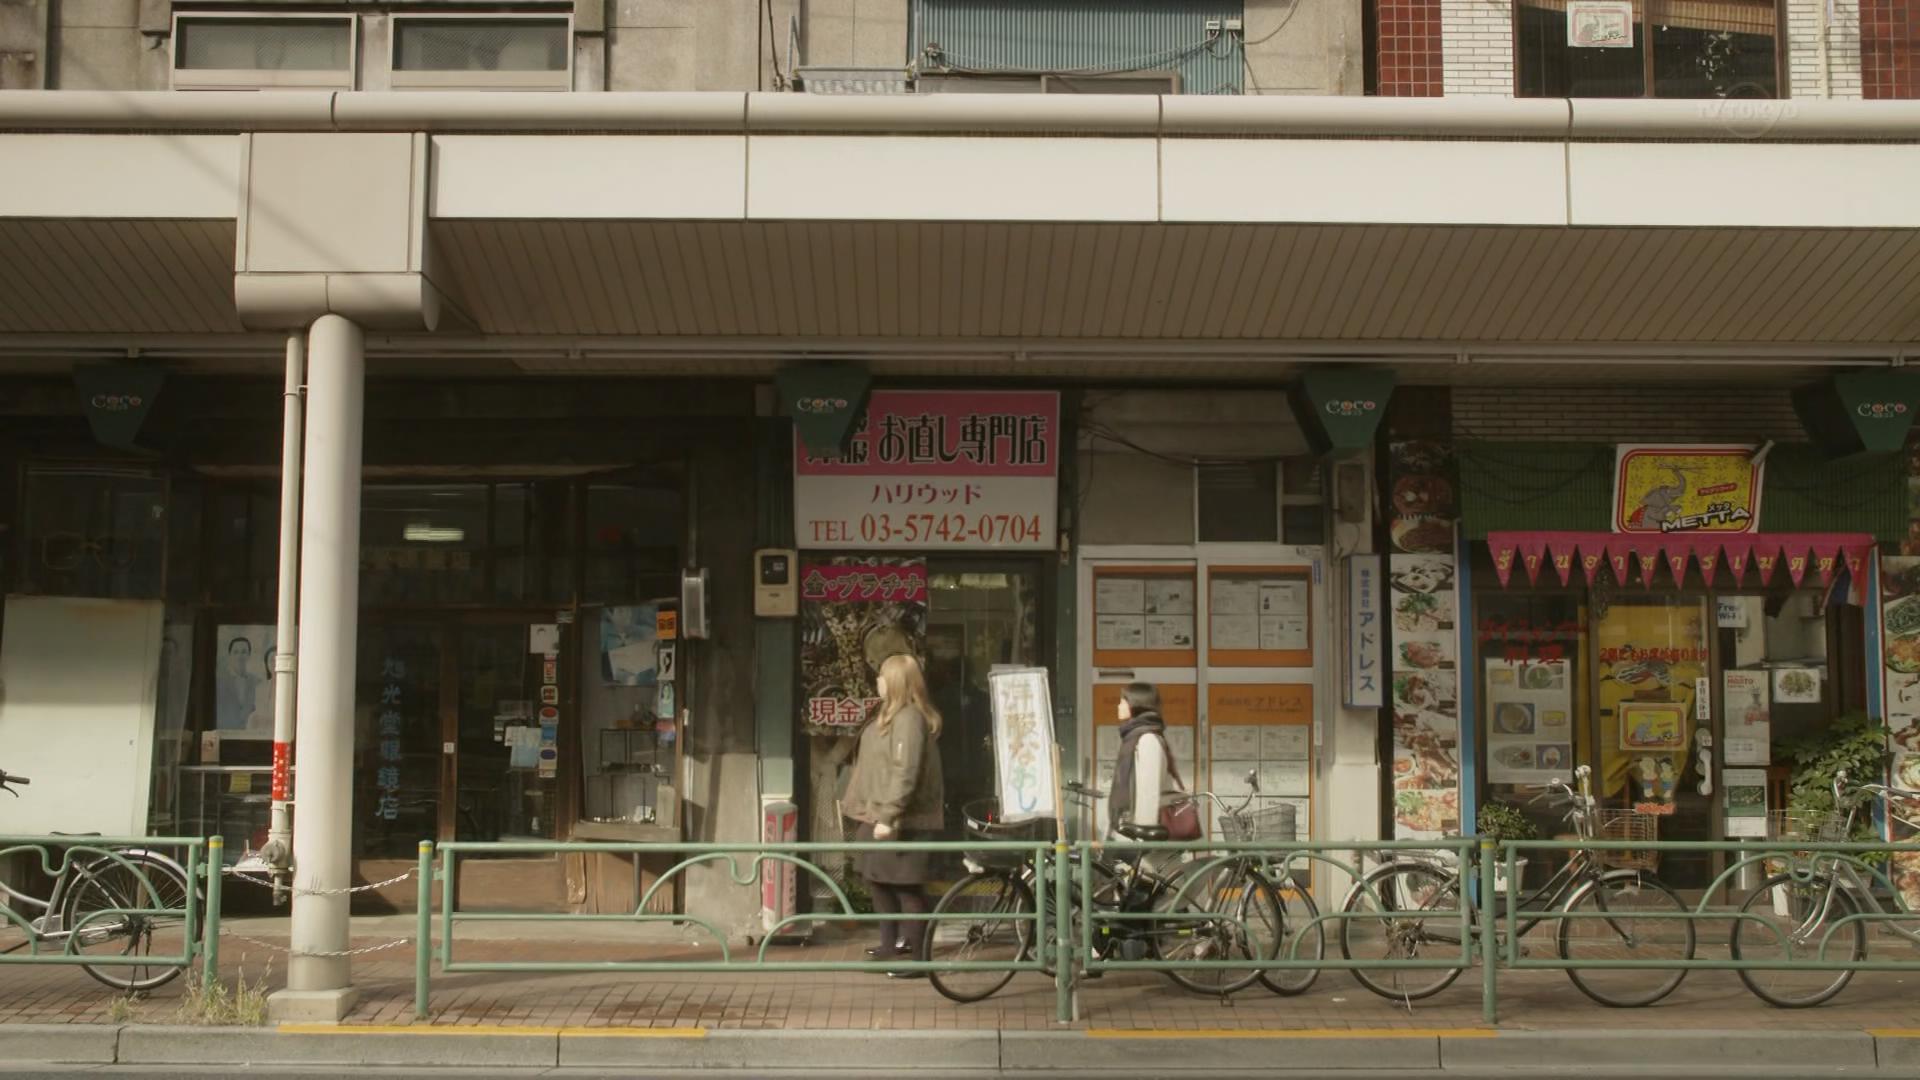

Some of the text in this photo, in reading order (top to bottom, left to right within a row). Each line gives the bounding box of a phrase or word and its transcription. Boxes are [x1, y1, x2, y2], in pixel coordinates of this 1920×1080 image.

[879, 413, 1048, 465] お直し専門店
[871, 483, 982, 505] ハリウッド
[809, 513, 1042, 543] TEL 03-5742-0704
[1661, 507, 1751, 534] METTA
[1359, 611, 1375, 691] アドレス
